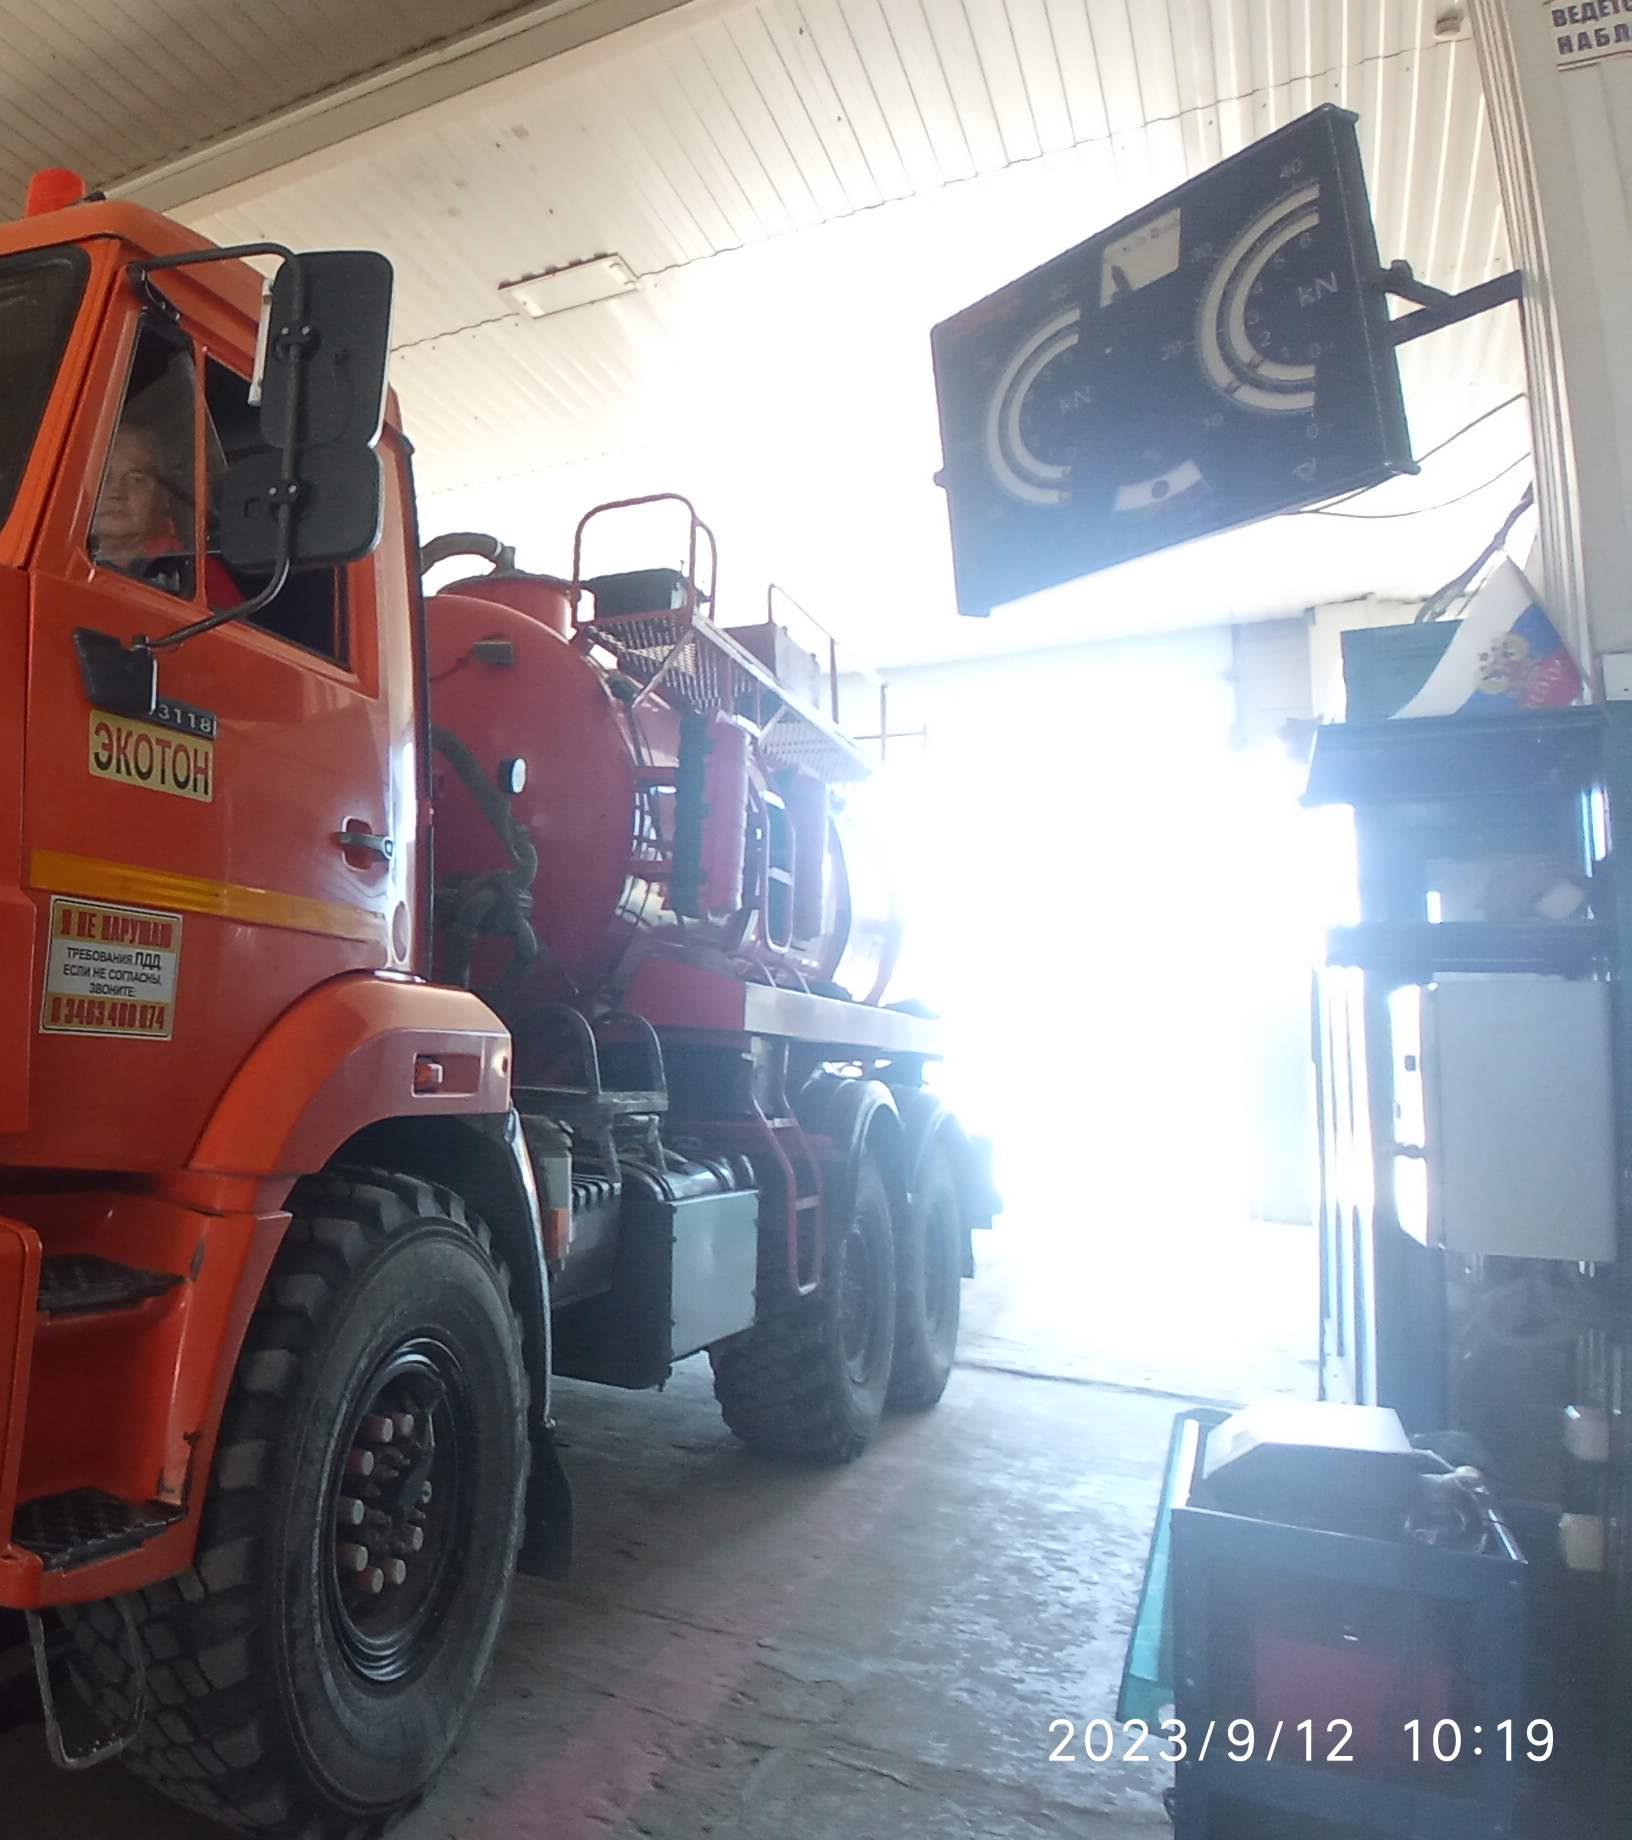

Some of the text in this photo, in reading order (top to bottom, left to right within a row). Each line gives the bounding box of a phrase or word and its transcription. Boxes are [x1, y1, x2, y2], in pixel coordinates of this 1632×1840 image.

[149, 704, 212, 733] 3118
[94, 722, 209, 795] ЭКОТОН
[77, 911, 96, 938] НЕ
[63, 964, 91, 977] ЕСЛИ
[93, 967, 106, 979] НЕ
[67, 947, 161, 970] ТРЕБОВАНИЯ ПДД
